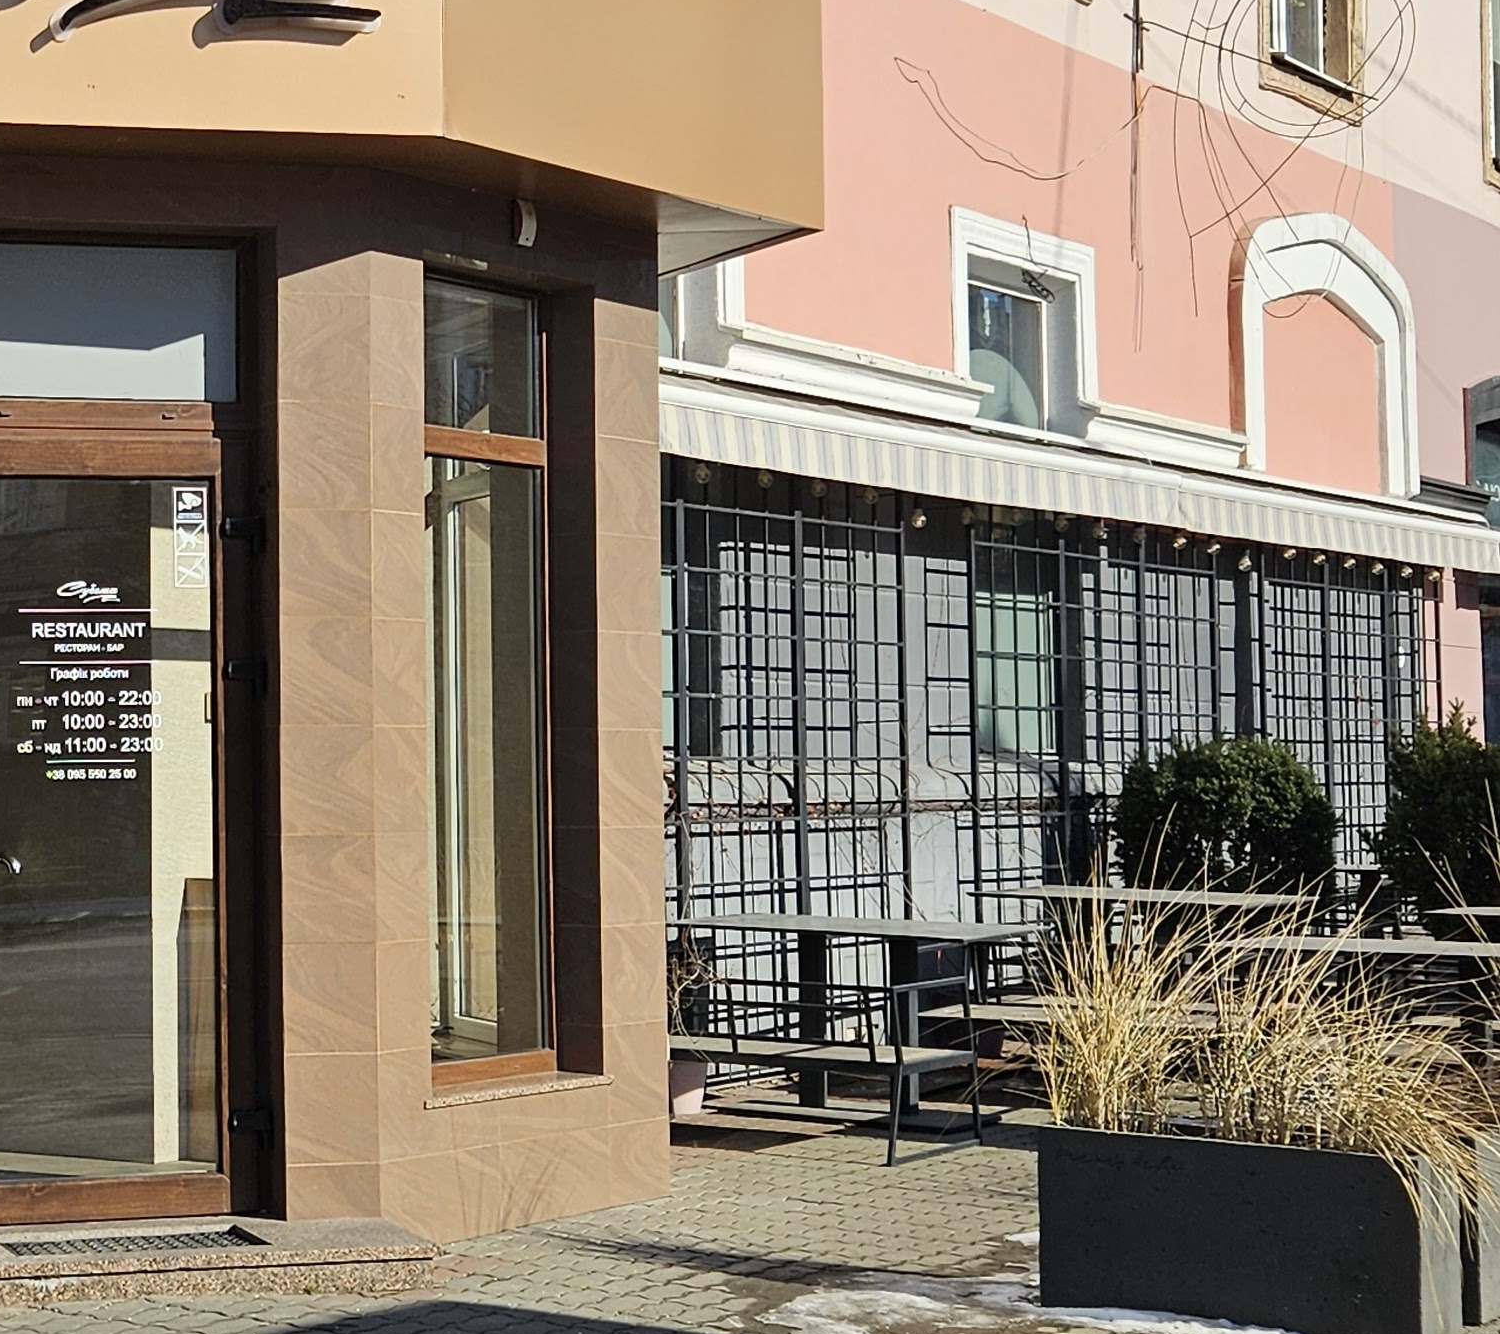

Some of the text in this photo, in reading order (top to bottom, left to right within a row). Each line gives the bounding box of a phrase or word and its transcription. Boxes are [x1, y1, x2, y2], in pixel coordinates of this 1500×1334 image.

[31, 623, 146, 638] RESTAURANT
[54, 644, 100, 653] РЕСТОРАН
[107, 644, 124, 652] БАР
[50, 668, 129, 681] Графік роботи
[17, 696, 33, 706] пн
[44, 696, 59, 706] чт
[61, 690, 105, 706] 10:00
[118, 690, 162, 706] 22:00
[31, 719, 47, 730] пт
[62, 714, 105, 730] 10:00
[118, 714, 162, 729] 23:00
[17, 740, 33, 753] сб
[44, 742, 62, 755] нд
[64, 737, 107, 753] 11:00
[120, 737, 164, 753] 23:00
[67, 769, 86, 780] 095
[108, 769, 122, 779] 25
[123, 769, 137, 779] 00
